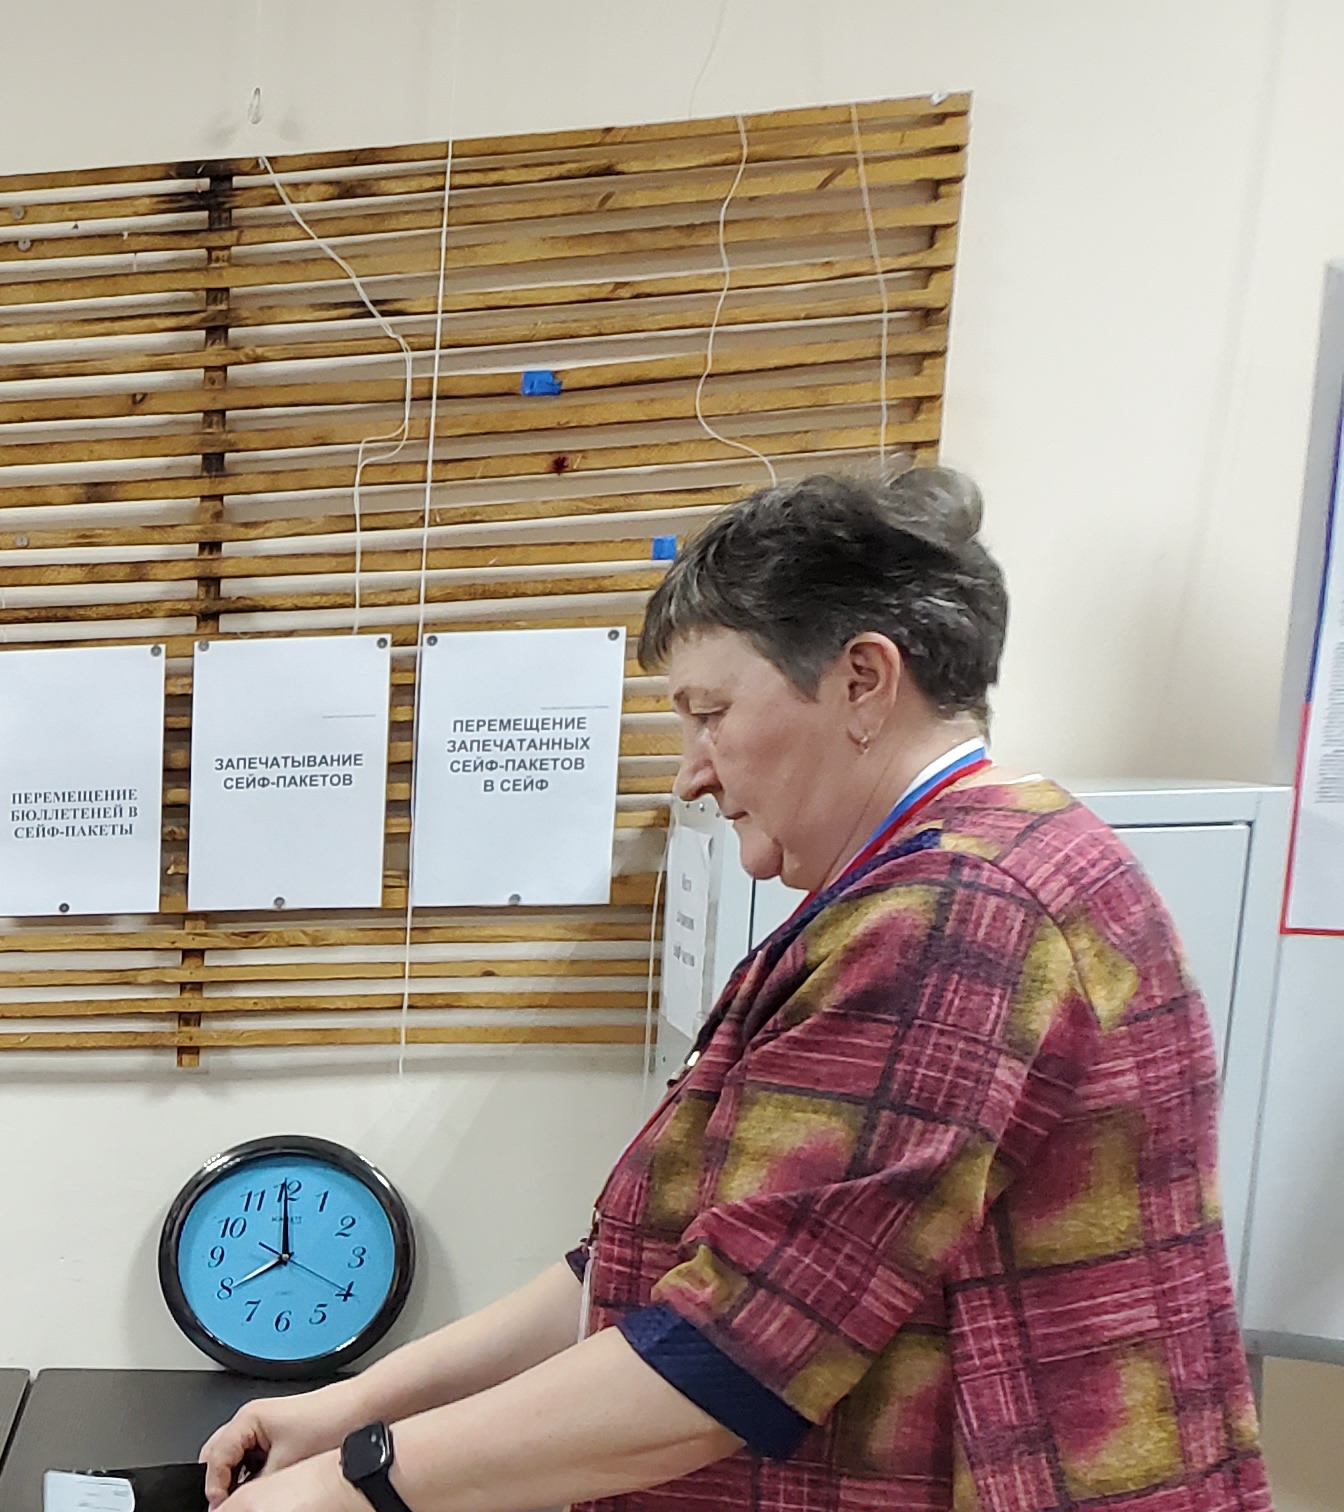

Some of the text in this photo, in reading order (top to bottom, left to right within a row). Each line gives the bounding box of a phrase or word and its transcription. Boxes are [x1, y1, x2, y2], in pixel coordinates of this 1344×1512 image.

[452, 716, 587, 732] ПЕРЕМЕЩЕНИЕ
[446, 737, 590, 752] ЗАПЕЧАТАННЫХ
[214, 753, 363, 770] ЗАПЕЧАТЫВАНИЕ
[449, 757, 585, 772] СЕЙФ-ПАКЕТОВ
[223, 773, 353, 789] СЕЙФ-ПАКЕТОВ
[483, 775, 549, 792] В СЕЙФ
[12, 788, 137, 804] ПЕРЕМЕЩЕНИЕ
[10, 804, 138, 821] БЮЛЛЕТЕНЕЙ В
[13, 823, 133, 838] СЕЙФ-ПАКЕТЫ
[240, 1189, 266, 1212] 11
[272, 1179, 303, 1203] 12
[312, 1190, 329, 1212] 1
[217, 1216, 247, 1239] 10
[334, 1215, 357, 1238] 2
[207, 1245, 225, 1268] 9
[347, 1246, 367, 1269] 3
[216, 1277, 235, 1301] 8
[334, 1280, 356, 1302] 4
[243, 1300, 262, 1322] 7
[274, 1310, 292, 1333] 6
[308, 1303, 328, 1325] 5
